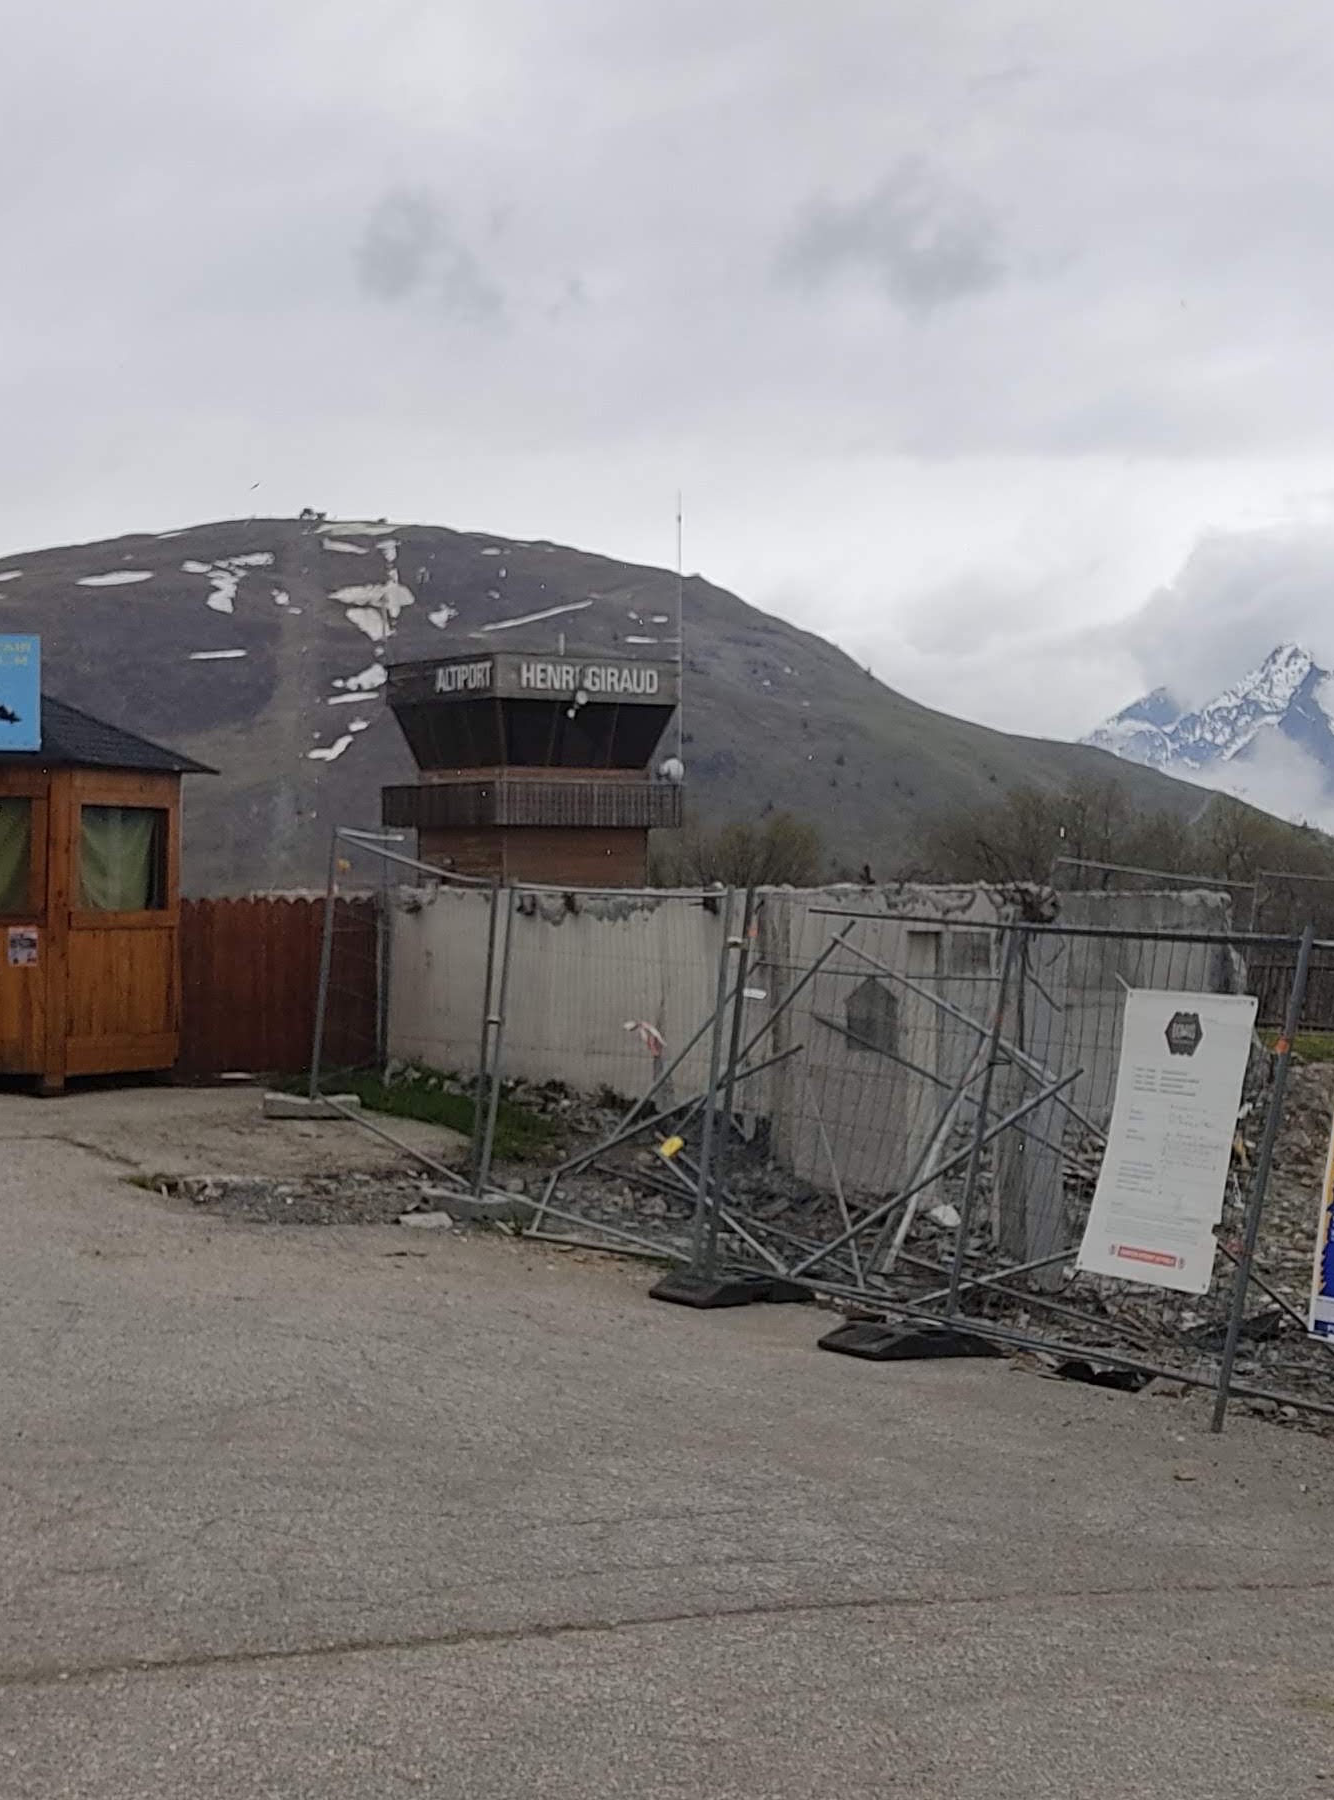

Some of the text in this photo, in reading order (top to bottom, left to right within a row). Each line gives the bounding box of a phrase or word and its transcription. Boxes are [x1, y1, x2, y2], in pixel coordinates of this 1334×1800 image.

[436, 660, 493, 694] ALTIPORT
[521, 660, 659, 694] HENRI GIRAUD
